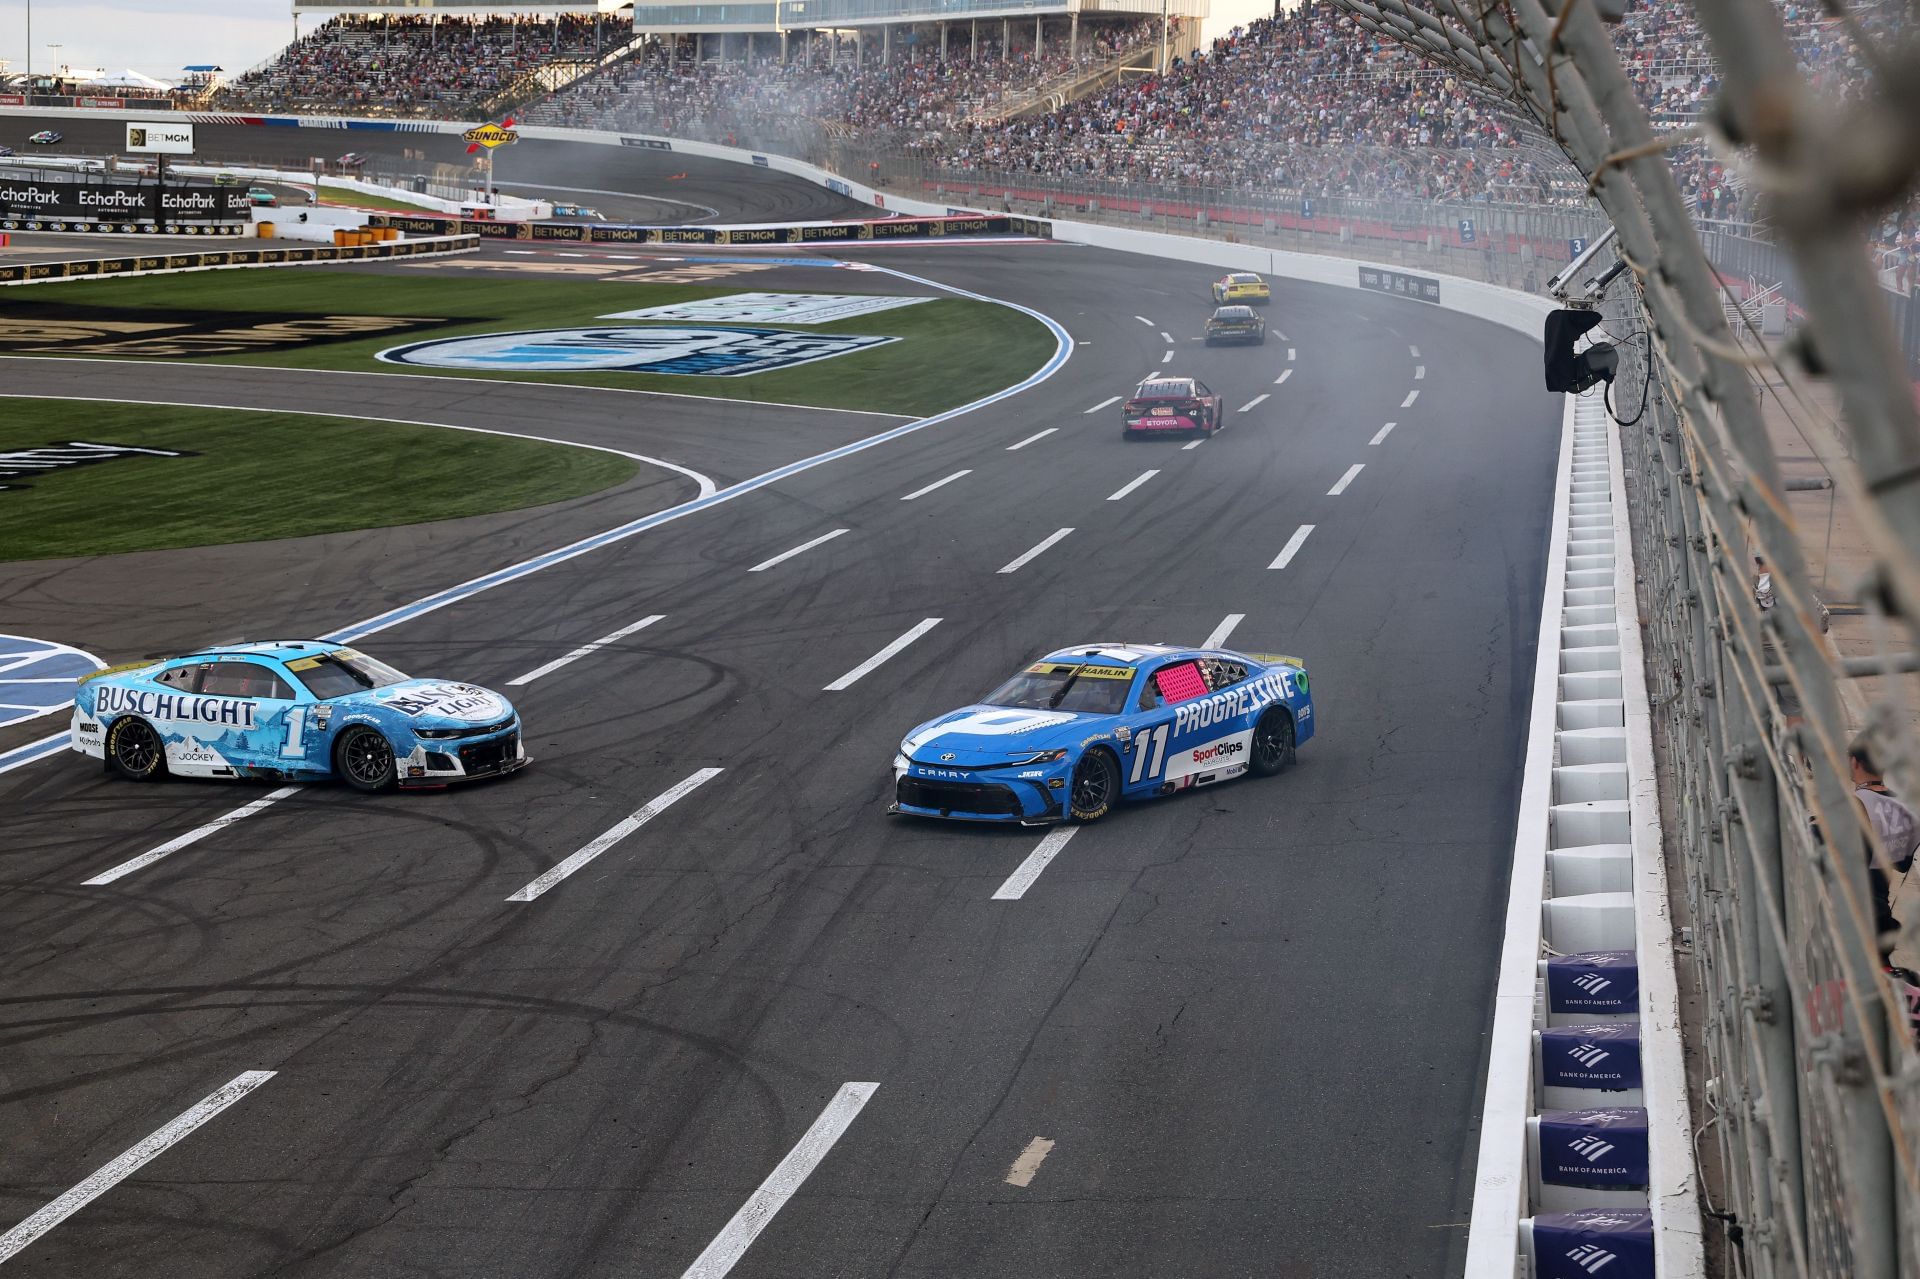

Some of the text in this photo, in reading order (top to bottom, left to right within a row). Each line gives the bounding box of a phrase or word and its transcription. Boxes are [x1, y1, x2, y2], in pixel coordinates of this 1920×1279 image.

[147, 133, 189, 142] BETMGM
[466, 131, 515, 142] SUNOCO
[0, 187, 60, 204] choPark
[79, 190, 145, 207] EchoPark
[162, 193, 215, 208] EchoPark
[565, 207, 576, 216] NC
[391, 220, 434, 231] BETMGM
[463, 223, 507, 235] BETMGM
[875, 224, 918, 235] BETMGM
[946, 220, 988, 231] BETMGM
[1462, 221, 1471, 231] 2
[534, 227, 579, 238] BETMGM
[593, 229, 637, 239] BETMGM
[664, 231, 704, 241] BETMGM
[732, 231, 775, 241] BETMGM
[804, 227, 848, 238] BETMGM
[1574, 239, 1582, 253] 3
[1083, 666, 1128, 677] HAMLIN
[438, 695, 493, 715] LIGHT
[1173, 671, 1295, 738] PROGRESSIVE
[343, 713, 381, 723] GOODYEAR
[79, 722, 99, 733] MOOSE
[279, 705, 309, 760] 1
[110, 716, 133, 756] GOODYEAR
[178, 752, 215, 762] JOCKEY
[1129, 723, 1170, 784] 11
[918, 768, 970, 779] CAMRY
[1017, 770, 1043, 778] JGR
